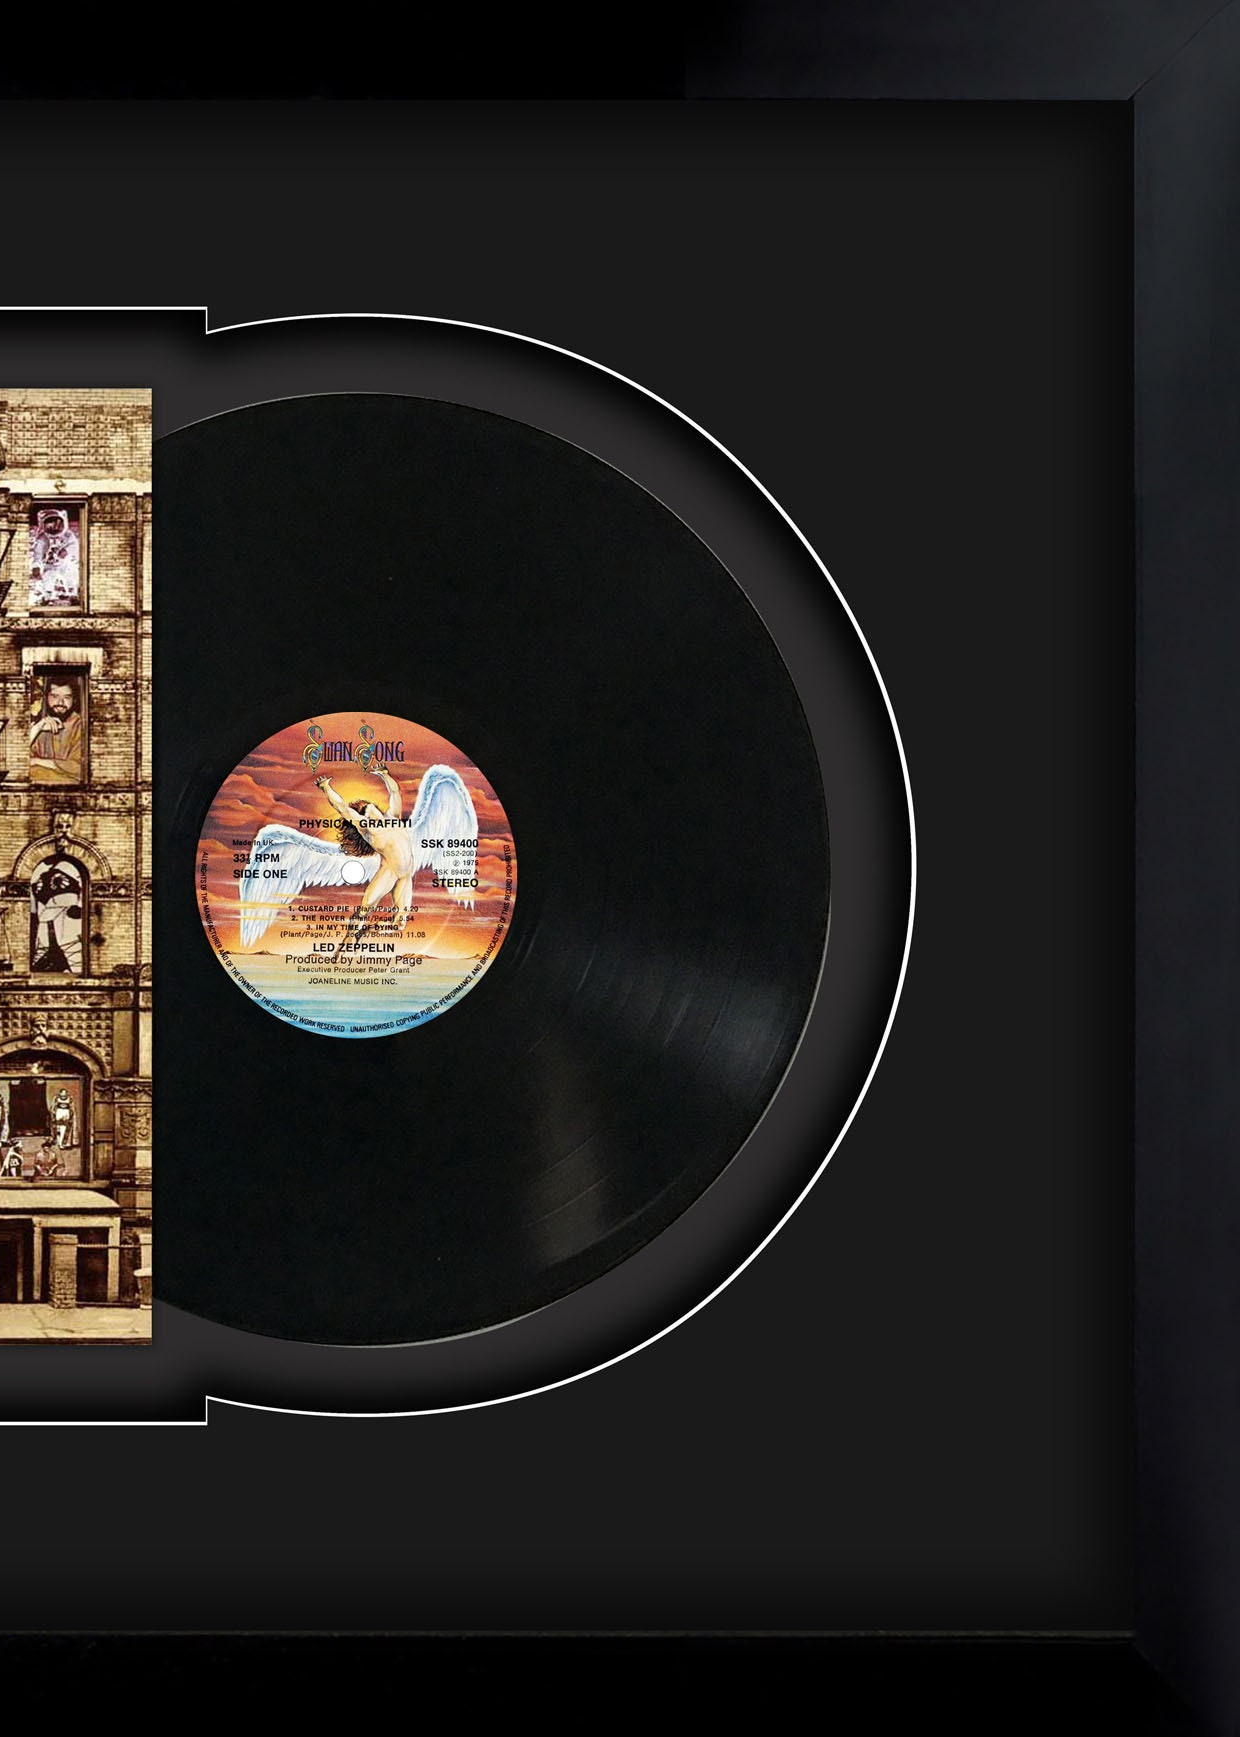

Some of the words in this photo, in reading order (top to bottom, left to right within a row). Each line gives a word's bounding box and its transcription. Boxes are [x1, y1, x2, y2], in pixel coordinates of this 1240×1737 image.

[299, 819, 353, 829] PHYSICAL
[359, 819, 412, 829] GRAFFITI
[421, 839, 444, 849] SSK
[447, 839, 479, 848] 89400
[255, 853, 280, 863] RPM
[233, 869, 260, 879] SIDE
[263, 869, 288, 879] ONE
[432, 878, 479, 888] STEREO
[313, 943, 335, 953] LED
[338, 943, 395, 953] ZEPPELIN
[285, 955, 337, 965] Produced
[340, 955, 353, 966] by
[356, 955, 392, 967] Jimmy
[395, 955, 423, 967] Page
[308, 977, 352, 985] JOANELINE
[353, 977, 379, 985] MUSIC
[381, 977, 398, 985] INC.
[230, 966, 242, 978] THE
[238, 975, 256, 995] OWNER
[261, 996, 272, 1007] THE
[270, 1003, 299, 1021] RECORDED
[299, 1016, 316, 1027] WORK
[315, 1021, 346, 1033] RESERVED
[419, 1002, 440, 1017] PUBLIC
